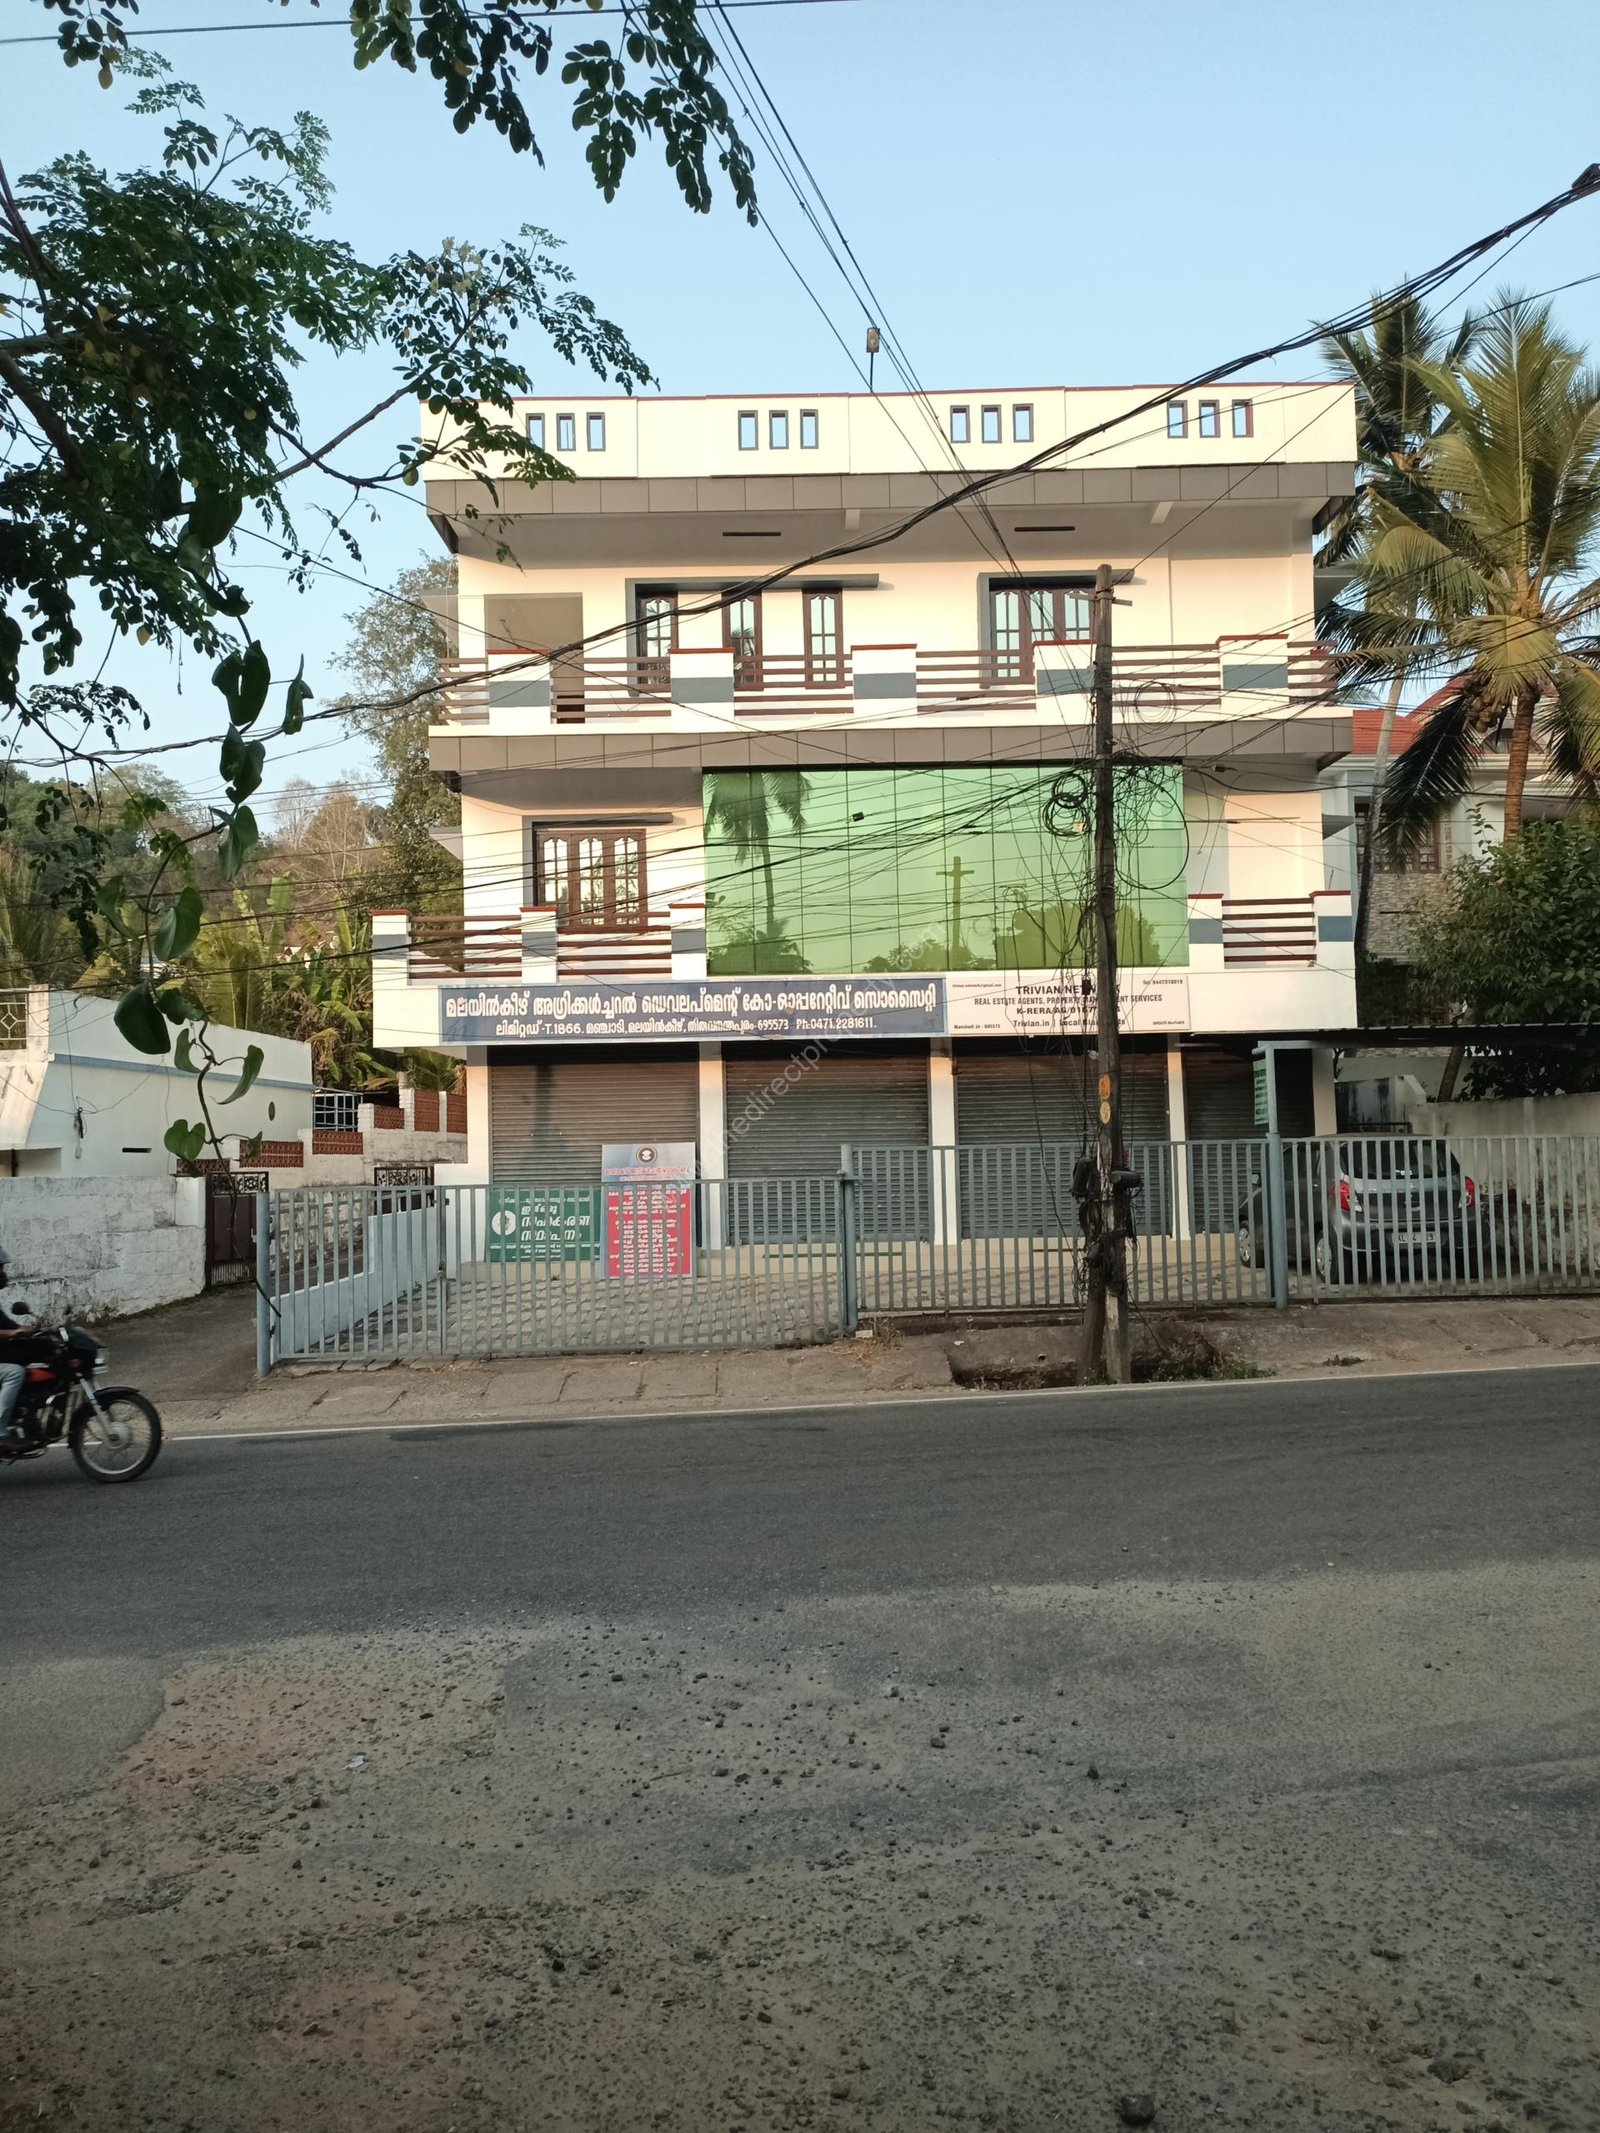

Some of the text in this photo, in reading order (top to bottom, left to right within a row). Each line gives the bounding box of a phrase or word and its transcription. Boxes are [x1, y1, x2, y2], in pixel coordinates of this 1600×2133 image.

[1015, 985, 1060, 995] TRIVIAN
[974, 997, 991, 1006] REAL
[1130, 994, 1163, 1003] SERVICES
